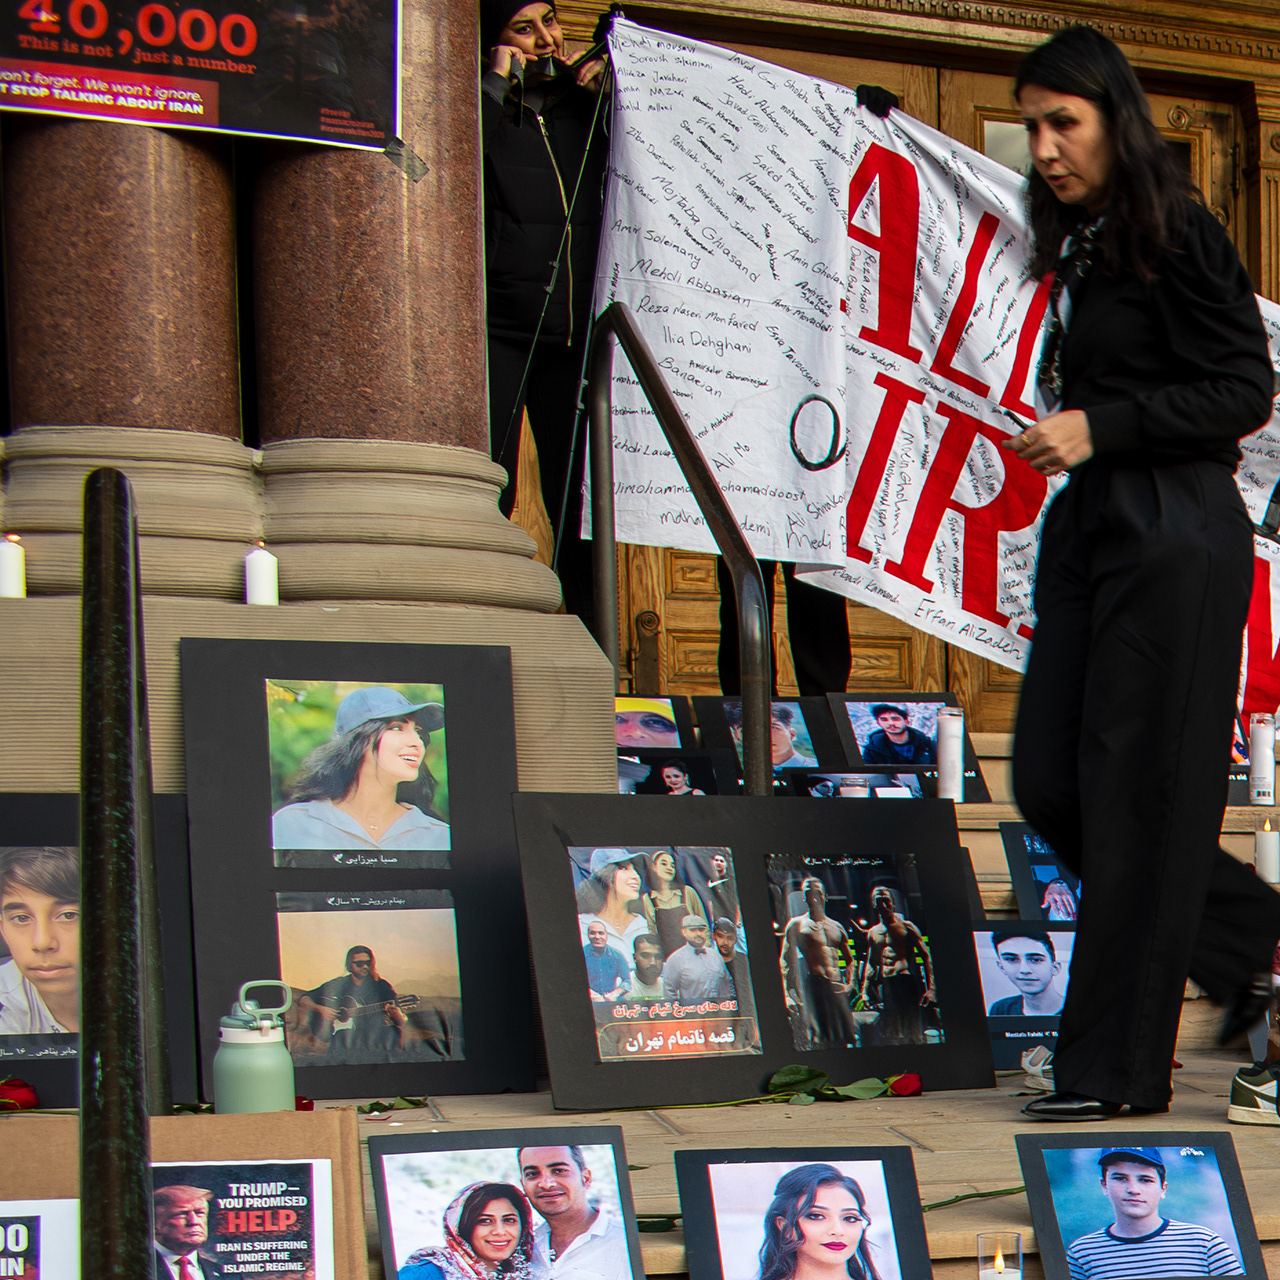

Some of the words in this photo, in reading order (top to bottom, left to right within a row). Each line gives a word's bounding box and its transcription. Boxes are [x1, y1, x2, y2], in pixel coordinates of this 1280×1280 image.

[18, 0, 257, 56] 40,000
[18, 34, 58, 51] This
[60, 40, 79, 53] is
[82, 43, 114, 58] not
[133, 47, 170, 65] just
[172, 55, 184, 66] a
[186, 57, 257, 74] number
[0, 69, 30, 83] on't
[33, 72, 80, 89] forget.
[84, 75, 109, 91] We
[110, 81, 152, 97] won't
[153, 85, 203, 102] ignore.
[11, 84, 50, 99] STOP
[52, 87, 114, 106] TALKING
[116, 94, 167, 111] ABOUT
[167, 99, 204, 115] IRAN
[610, 218, 642, 234] Amir
[643, 230, 702, 270] Soleimany
[629, 258, 681, 284] Mehdi
[687, 276, 752, 308] Abbasian
[636, 294, 669, 314] Reza
[673, 302, 703, 320] Naseri
[690, 330, 752, 357] Dehghani
[914, 598, 956, 630] Erfan
[625, 1032, 664, 1052] تهران
[667, 1029, 705, 1050] ناتمام
[708, 1026, 736, 1043] قصه
[218, 1197, 245, 1209] YOU
[245, 1195, 308, 1208] PROMISED
[227, 1209, 298, 1233] HELP
[216, 1242, 241, 1253] IRAN
[242, 1241, 253, 1252] IS
[253, 1239, 308, 1251] SUFFERING
[236, 1251, 269, 1262] UNDER
[270, 1250, 290, 1261] THE
[223, 1262, 264, 1274] ISLAMIC
[265, 1261, 306, 1272] REGIME.
